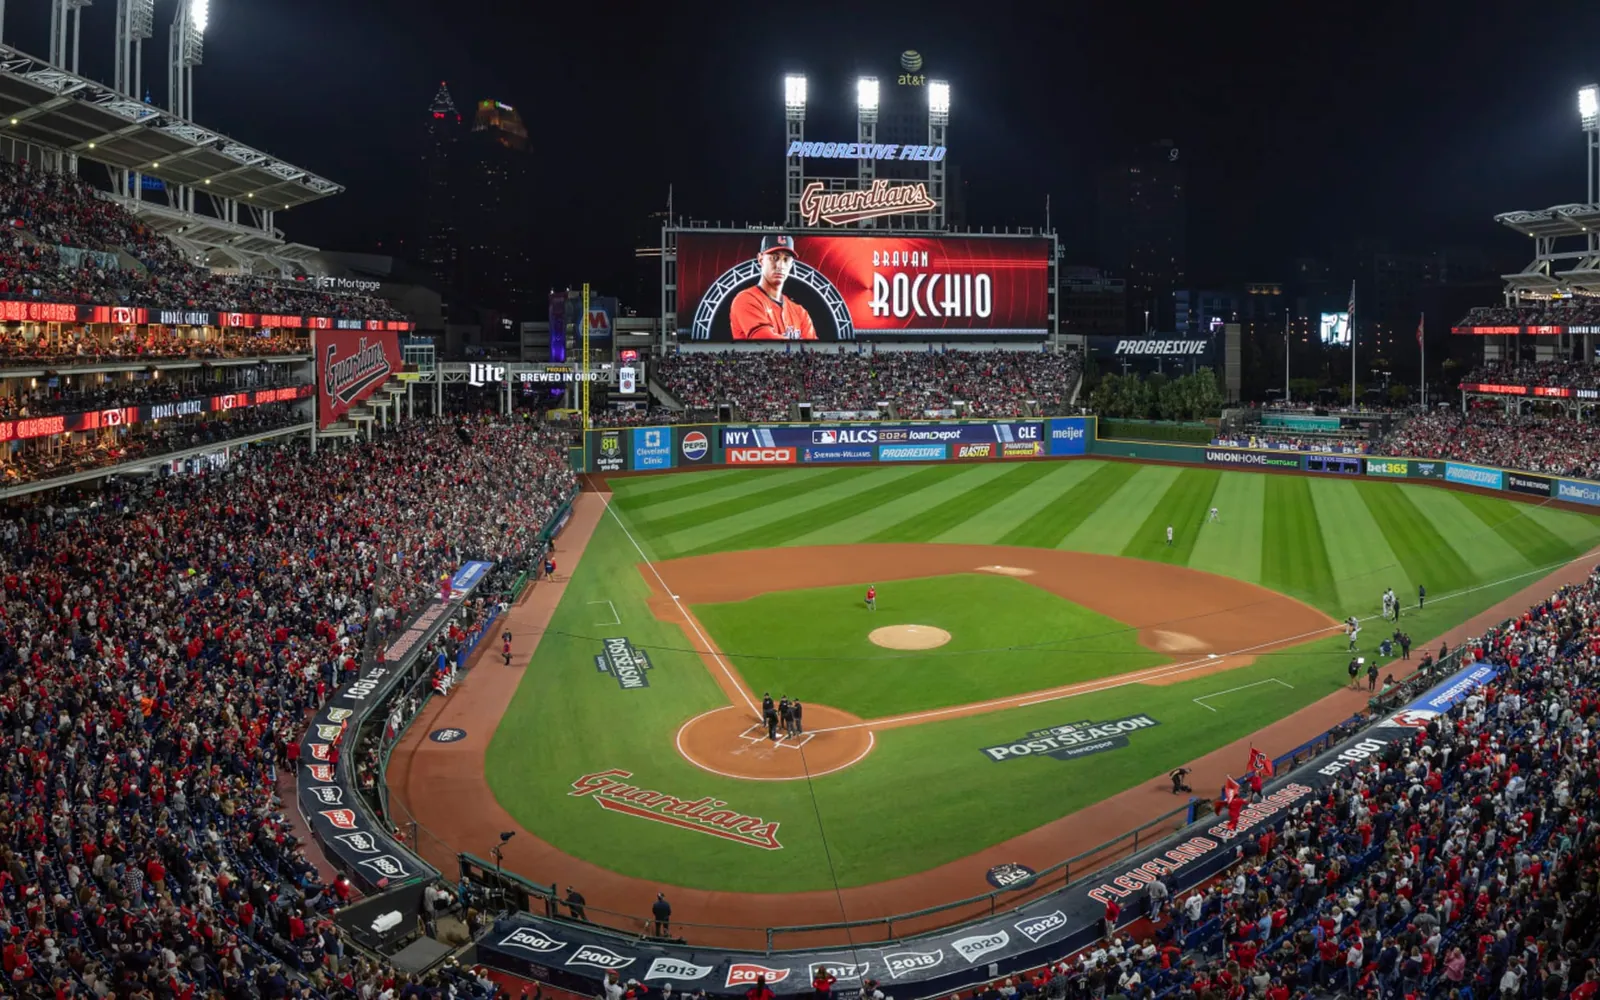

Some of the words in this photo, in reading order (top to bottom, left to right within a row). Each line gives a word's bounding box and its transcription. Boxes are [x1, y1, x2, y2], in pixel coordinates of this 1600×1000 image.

[898, 73, 926, 86] at&t
[787, 141, 899, 160] PROGRESSIVE
[899, 145, 946, 161] FIELD
[800, 179, 936, 226] Guardians
[873, 250, 929, 268] BRAYAN
[338, 278, 381, 292] Mortgage
[868, 273, 992, 318] ROCCHIO
[1115, 340, 1208, 355] PROGRESSIVE
[325, 337, 391, 409] Guardians
[468, 362, 505, 387] Lite
[520, 373, 562, 382] BREWED
[562, 373, 573, 382] IN
[726, 432, 749, 445] NYY
[838, 430, 877, 443] ALCS
[909, 428, 961, 441] loanDepot
[1018, 427, 1036, 438] CLE
[1052, 427, 1084, 440] meijer
[602, 438, 617, 449] 811
[683, 442, 708, 450] PEPSI
[636, 446, 670, 456] Cleveland
[731, 449, 790, 461] NOCO
[881, 447, 943, 458] PROGRESSIVE
[958, 445, 990, 457] BLASTER
[643, 456, 663, 465] Clinic
[1367, 461, 1408, 475] bet365
[606, 638, 643, 688] POSTSEASON
[986, 717, 1156, 760] POSTSEASON
[1339, 738, 1388, 763] 1901
[567, 768, 784, 850] Guardians
[1087, 836, 1219, 905] CLEVELAND
[1024, 915, 1064, 936] 2022
[512, 932, 552, 950] 2001
[961, 936, 1004, 954] 2020
[577, 950, 622, 967] 2007
[891, 954, 935, 970] 2018
[653, 963, 698, 977] 2013
[815, 966, 856, 978] 017
